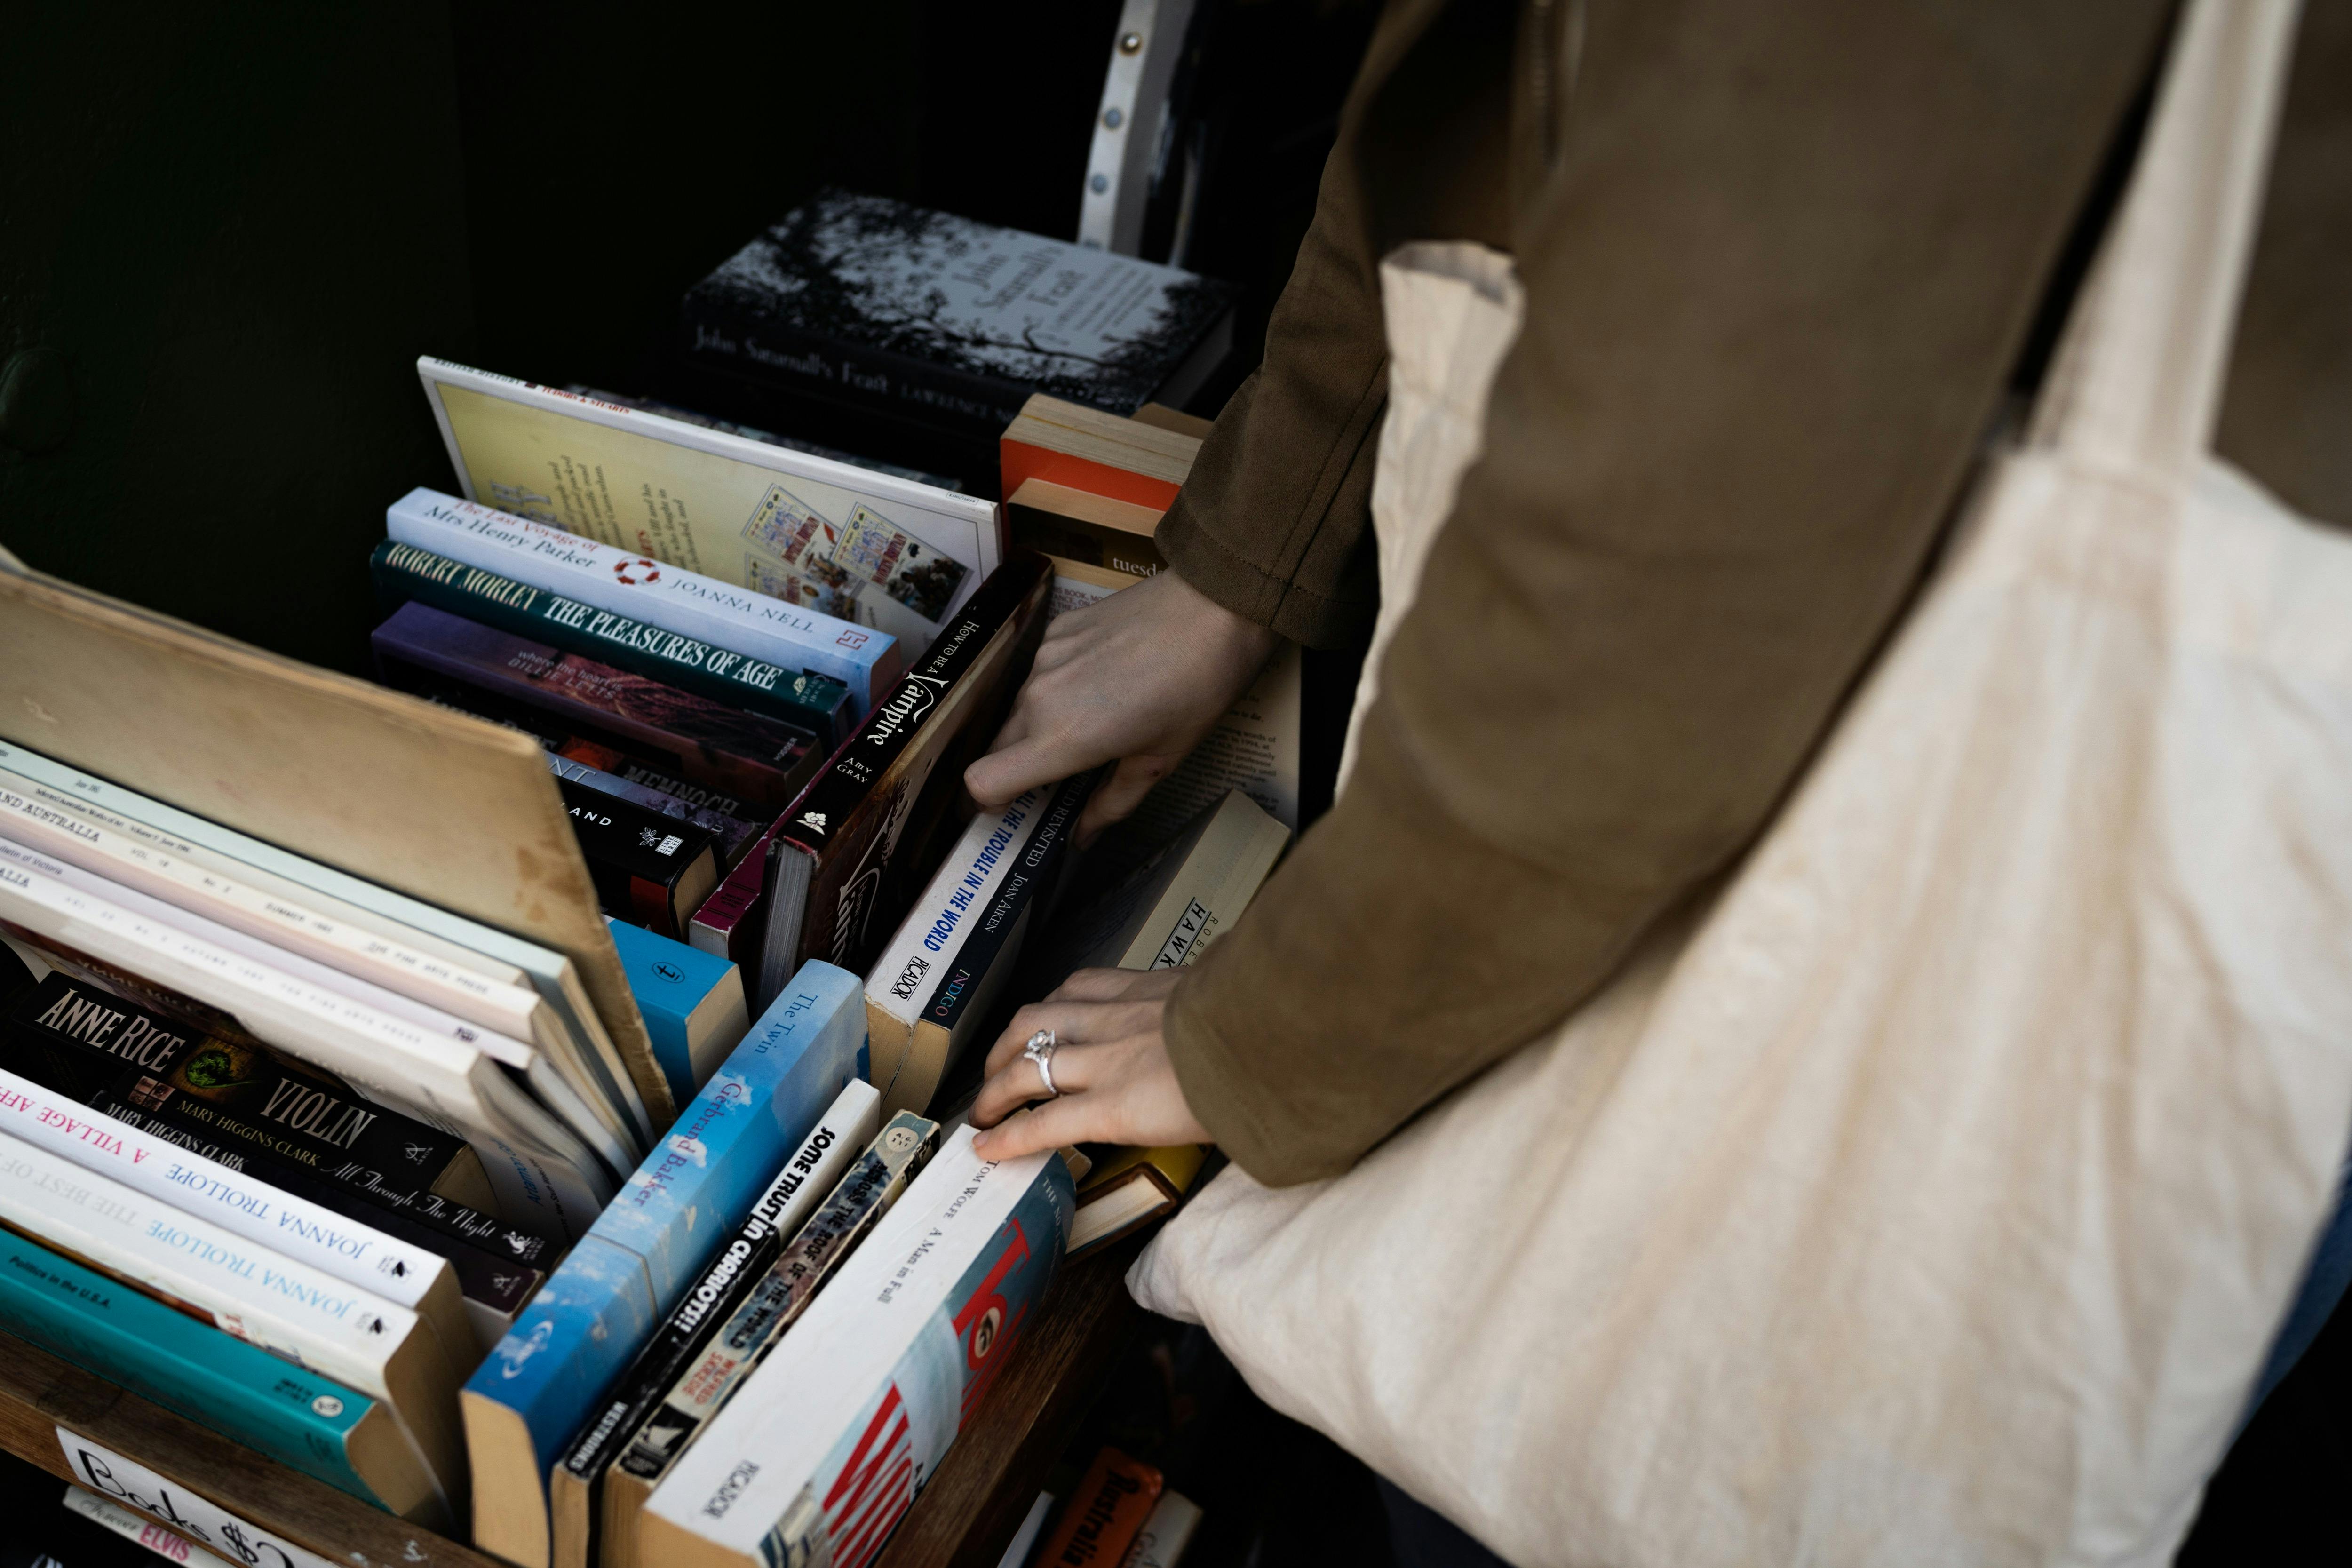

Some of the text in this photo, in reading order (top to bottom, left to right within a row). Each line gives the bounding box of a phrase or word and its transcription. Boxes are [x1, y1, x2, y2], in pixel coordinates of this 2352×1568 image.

[424, 505, 596, 567] Mrs Henry Parker
[453, 500, 604, 553] The Last Voyage of
[386, 543, 544, 611] ROBERT MORLEY
[669, 579, 813, 633] JOANNA NELL
[544, 596, 783, 691] THE PLEASURES OF AGE
[936, 655, 949, 668] BE
[508, 658, 617, 700] BILLIE LETTS
[518, 650, 554, 668] where
[577, 670, 608, 687] heart
[608, 679, 623, 691] is
[867, 671, 949, 746] Vampire
[561, 803, 612, 826] AND
[626, 765, 739, 816] MEMNOCH
[1002, 801, 1025, 830] THE
[23, 803, 100, 843] AUSTRALIA
[660, 836, 674, 852] LIME
[666, 837, 681, 855] TREE
[32, 858, 63, 875] Victoria
[973, 826, 1013, 875] TROUBLE
[984, 806, 1069, 934] REVISITED JOAN AIKEN
[950, 891, 975, 912] THE
[964, 872, 984, 890] IN
[923, 909, 961, 951] WORLD
[1160, 902, 1206, 968] HAWK
[892, 957, 929, 1000] PICADOR
[935, 968, 971, 1017] INDIGO
[35, 988, 127, 1048] ANNE
[108, 1015, 186, 1072] RICE
[754, 992, 818, 1054] The Twin
[36, 1106, 124, 1156] VILLAGE
[103, 1103, 249, 1172] MARY HIGGINS CLARK
[260, 1078, 377, 1150] VIOLIN
[132, 1148, 151, 1163] A
[177, 1100, 495, 1238] MARY HIGGINS CLARK All Through The Night
[634, 1083, 743, 1206] Gerbrand Bakker
[794, 1126, 836, 1175] SOME
[165, 1163, 270, 1219] TROLLOPE
[760, 1172, 805, 1221] TRUST
[1042, 1177, 1058, 1205] THE
[2, 1159, 352, 1319] JOANNA TROLLOPE THE BEST OF
[279, 1211, 373, 1260] JOANNA
[726, 1158, 888, 1351] ACROSS THE ROOF OF THE WORLD
[877, 1159, 1000, 1305] TOM WOLFE A Man in Full
[9, 1255, 111, 1310] Politics in the U.S.A.
[78, 1448, 211, 1542] Books
[1061, 1467, 1141, 1568] Australia
[139, 1521, 194, 1563] ELVIS
